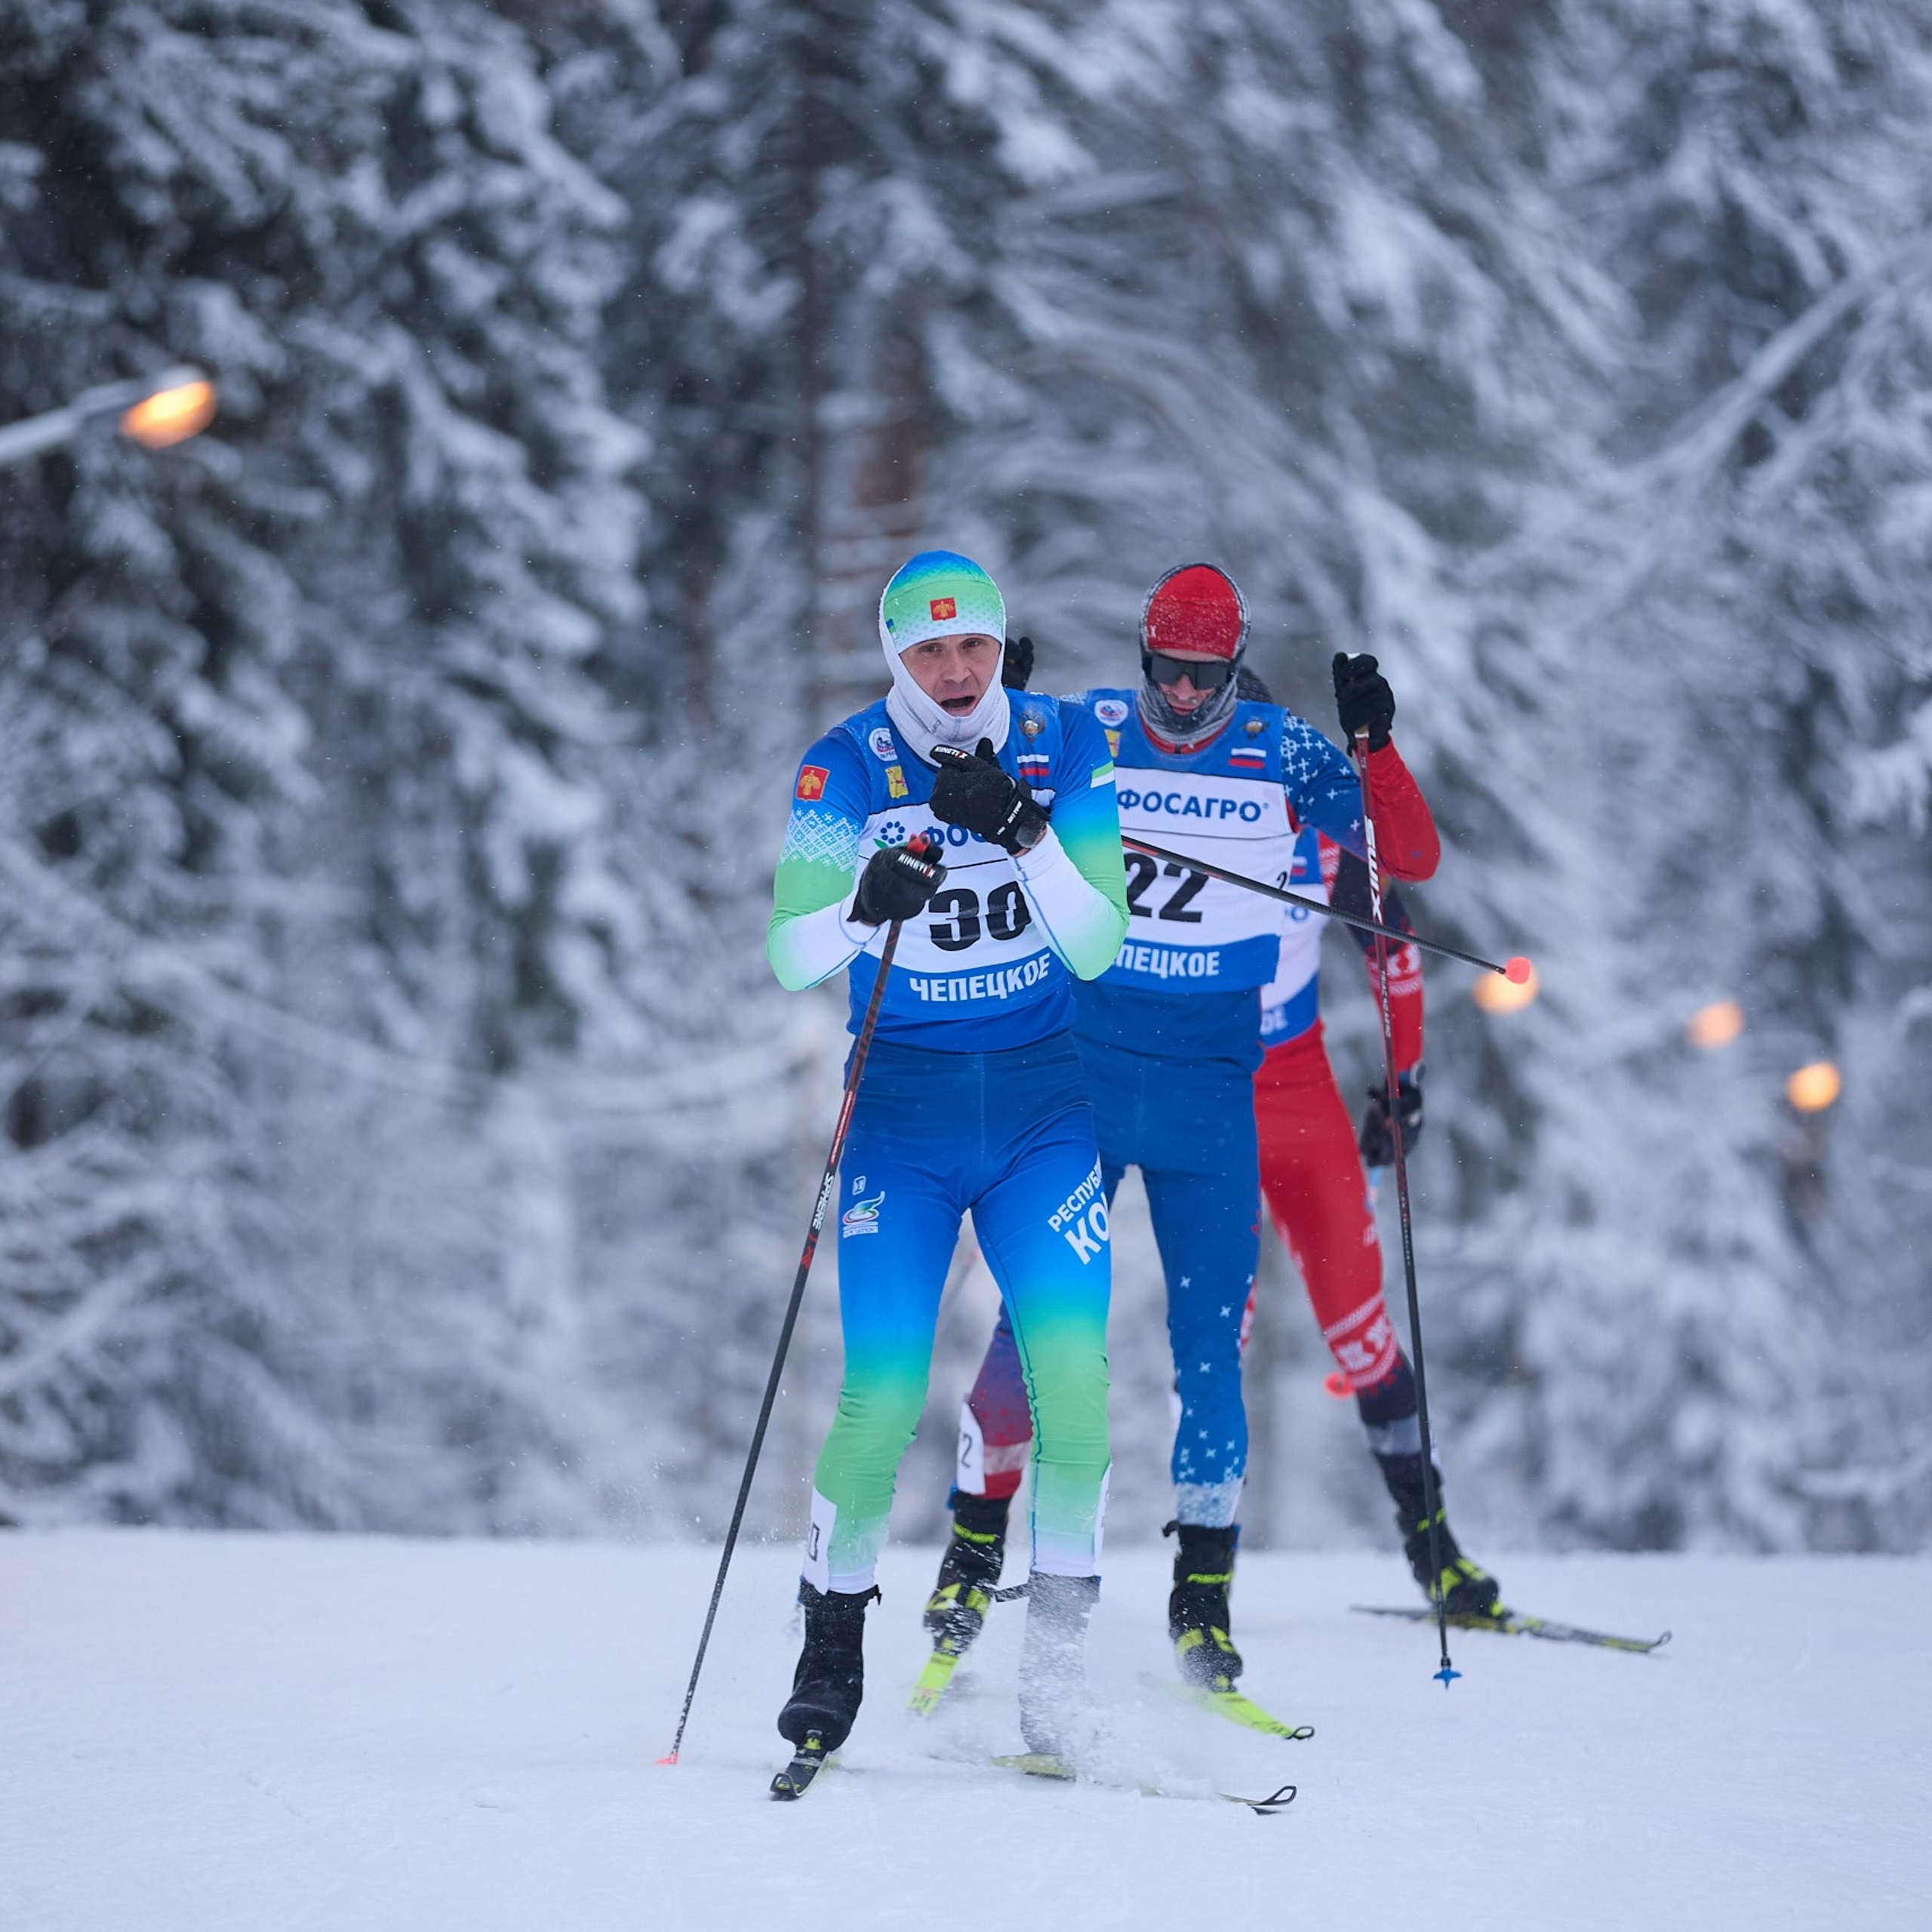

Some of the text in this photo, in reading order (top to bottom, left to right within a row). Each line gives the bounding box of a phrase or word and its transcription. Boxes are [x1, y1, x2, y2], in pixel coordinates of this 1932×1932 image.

[1117, 789, 1261, 822] ФОСАГРО
[1124, 852, 1209, 923] 22
[1364, 815, 1383, 925] SWIX
[928, 881, 1032, 952] 30
[909, 953, 1050, 1001] ЧЕПЕЦКОЕ
[1115, 943, 1220, 979] ПЕЦКОЕ
[813, 1172, 834, 1230] SPHERE
[1064, 1192, 1109, 1265] КО
